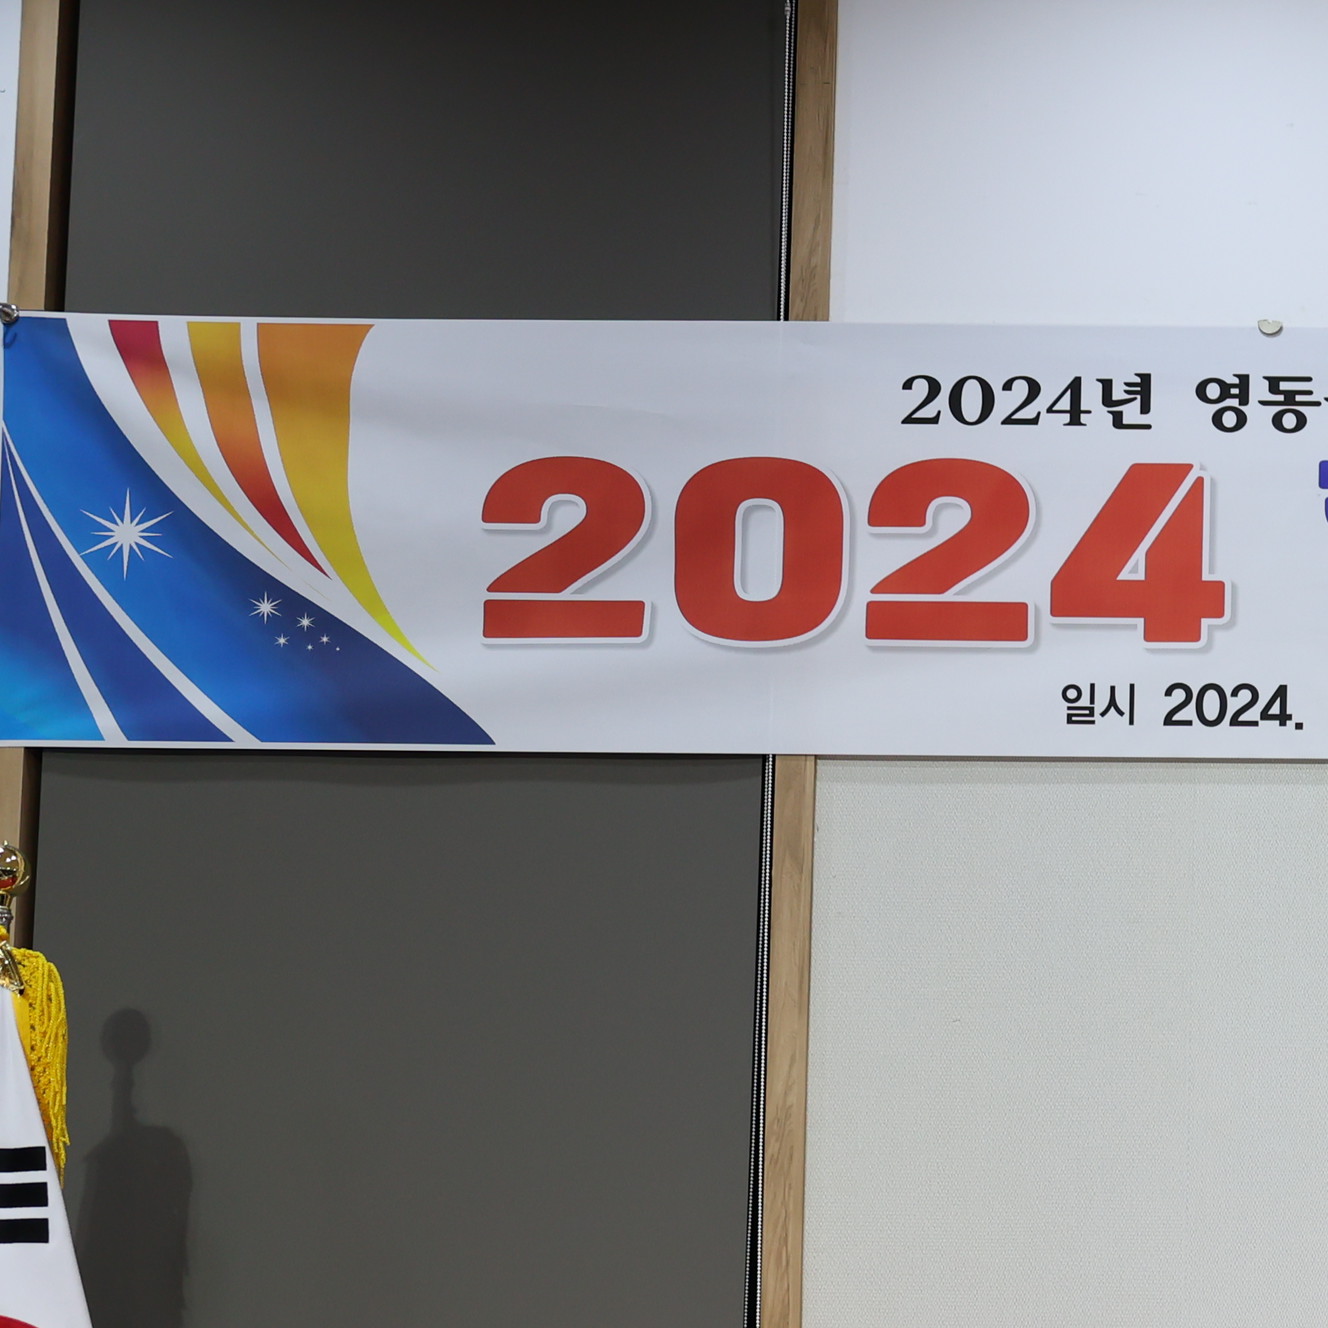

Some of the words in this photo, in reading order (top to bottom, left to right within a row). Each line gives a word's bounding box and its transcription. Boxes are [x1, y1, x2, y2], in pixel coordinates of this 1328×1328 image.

[900, 372, 1153, 431] 2024년
[480, 456, 1226, 644] 2024
[1061, 682, 1136, 727] 일시
[1162, 682, 1305, 731] 2024.
